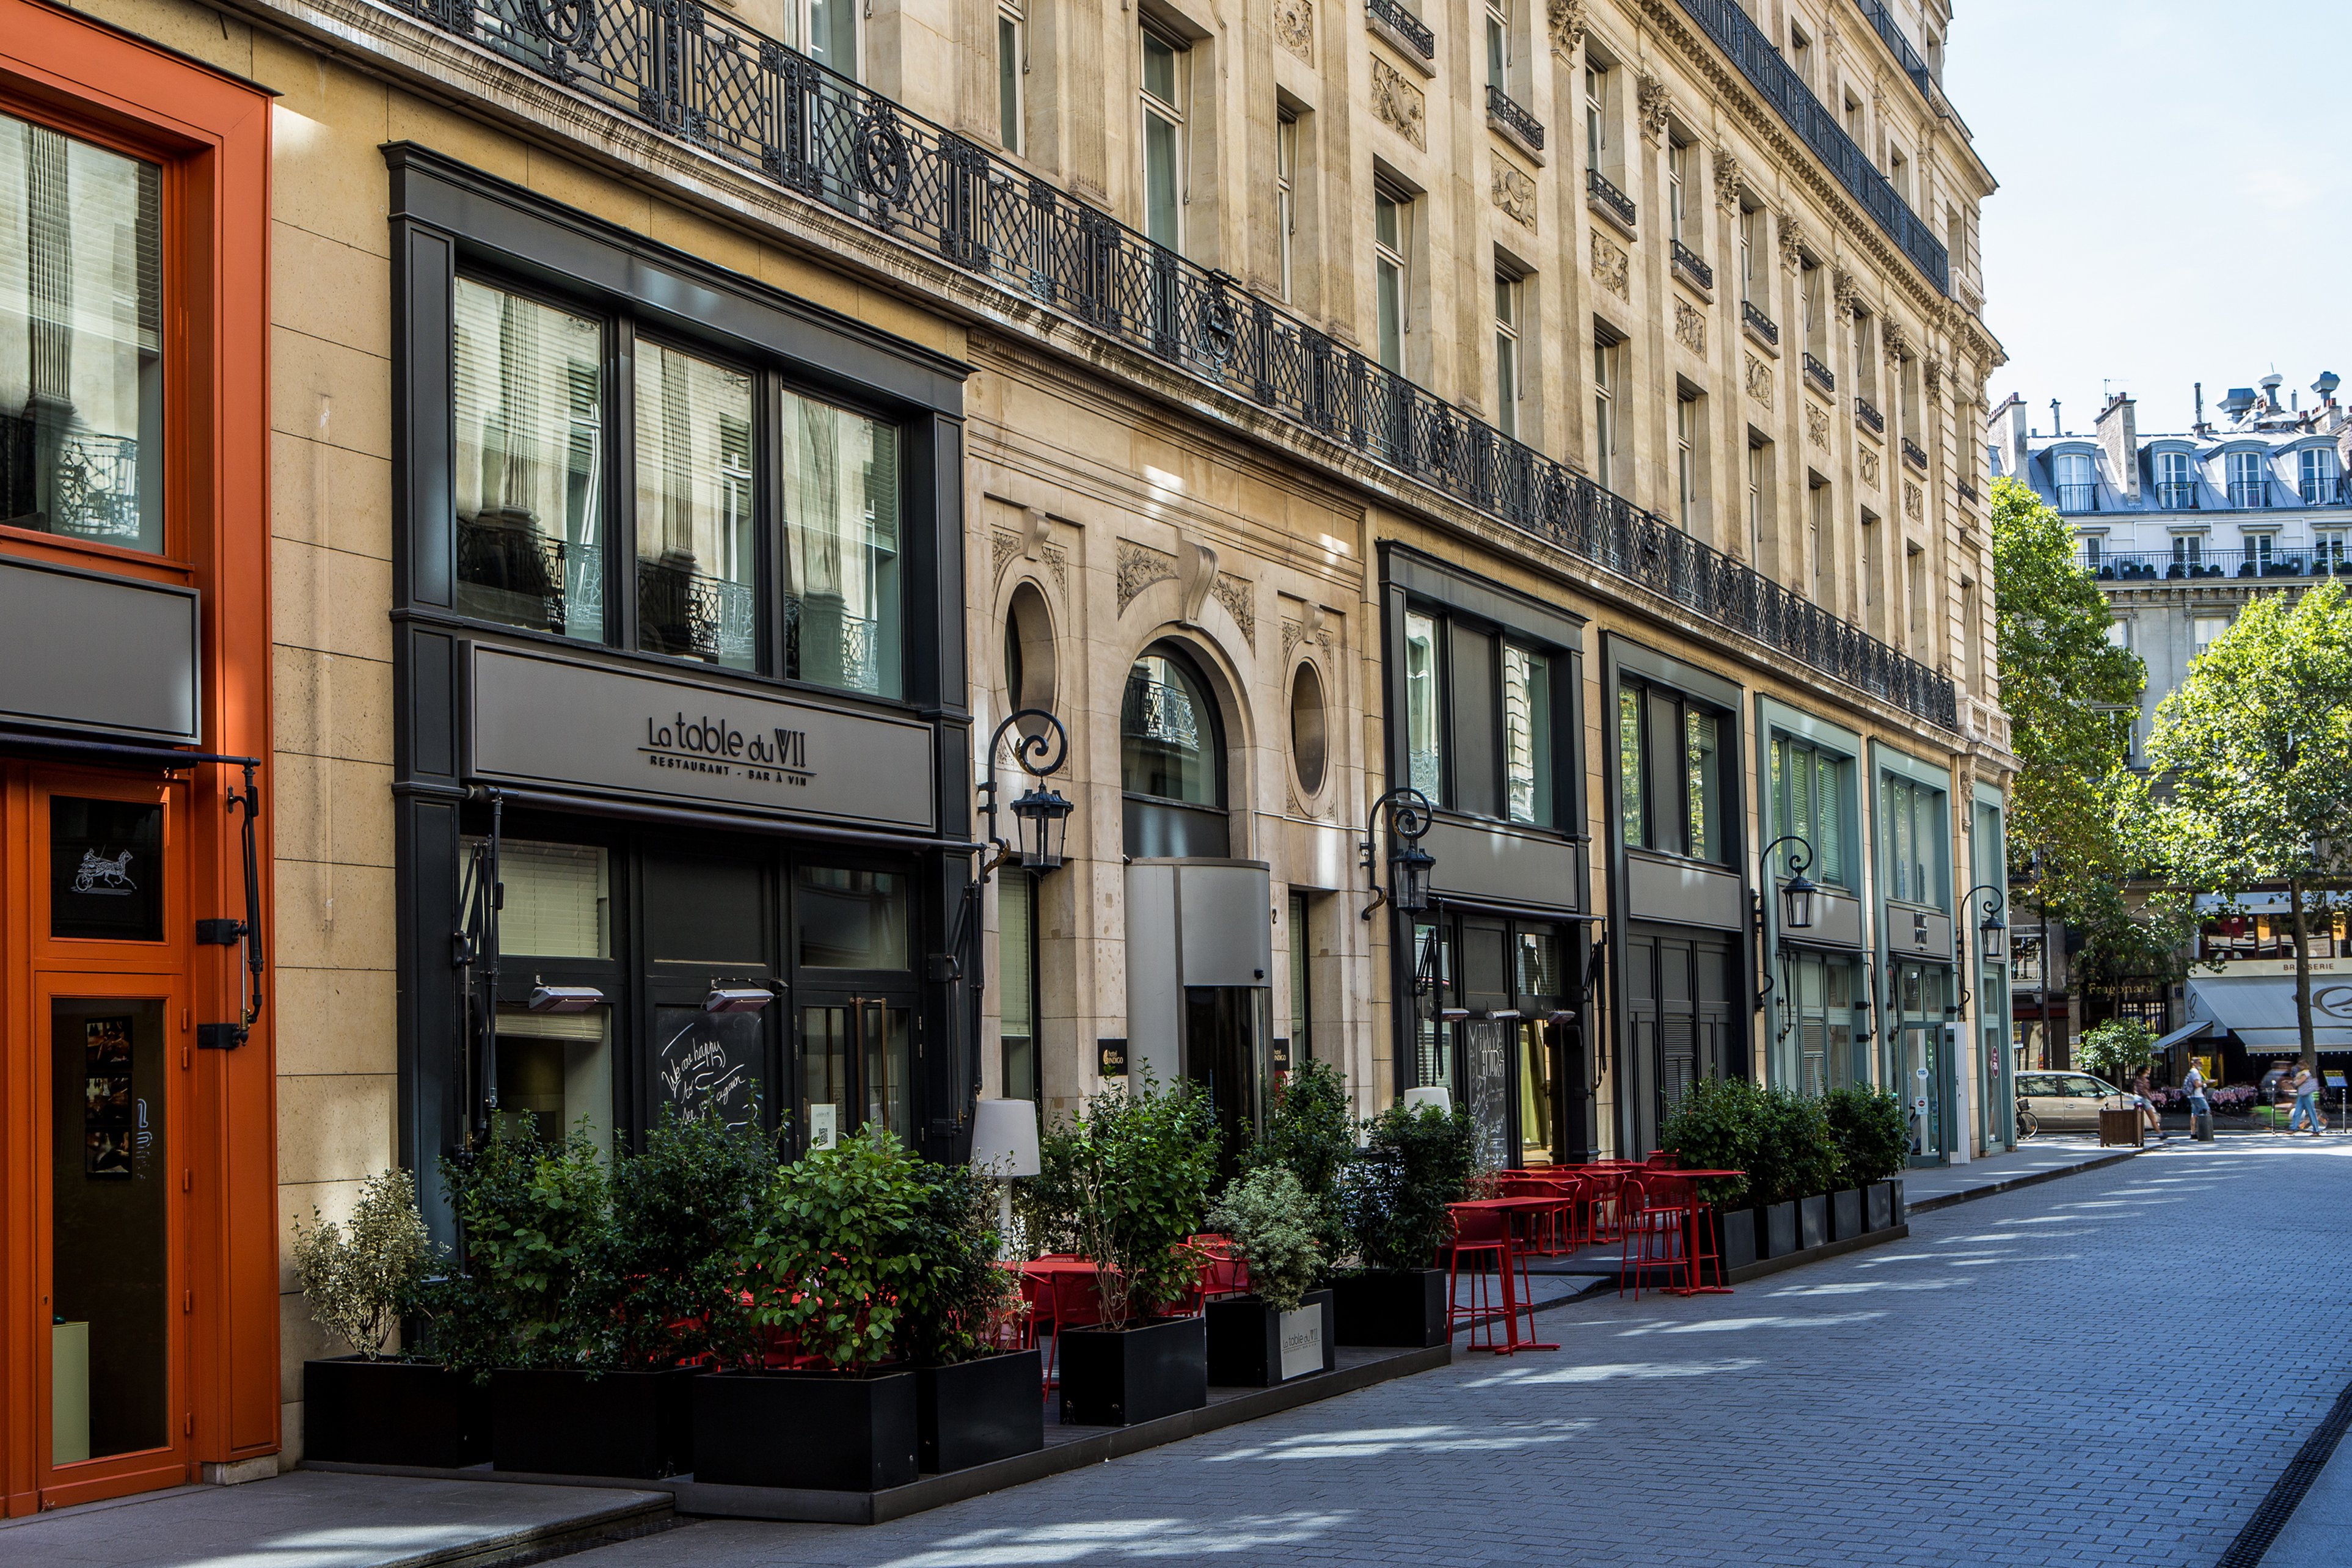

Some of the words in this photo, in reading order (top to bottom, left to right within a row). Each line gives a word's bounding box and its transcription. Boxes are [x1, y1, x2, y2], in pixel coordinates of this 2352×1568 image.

[649, 717, 671, 747] La
[675, 712, 743, 757] table
[748, 734, 774, 763] du
[774, 727, 806, 768] VII
[650, 755, 730, 775] RESTAURANT
[748, 769, 770, 781] BAR
[776, 771, 783, 783] À
[788, 775, 806, 786] VIN
[2284, 963, 2334, 971] BRSERIE
[662, 1059, 681, 1091] We
[693, 1038, 726, 1068] happy
[681, 1080, 694, 1104] to
[716, 1076, 747, 1105] again
[1283, 1340, 1288, 1349] La
[1288, 1332, 1304, 1346] table
[1304, 1333, 1310, 1343] du
[1309, 1328, 1318, 1341] VII
